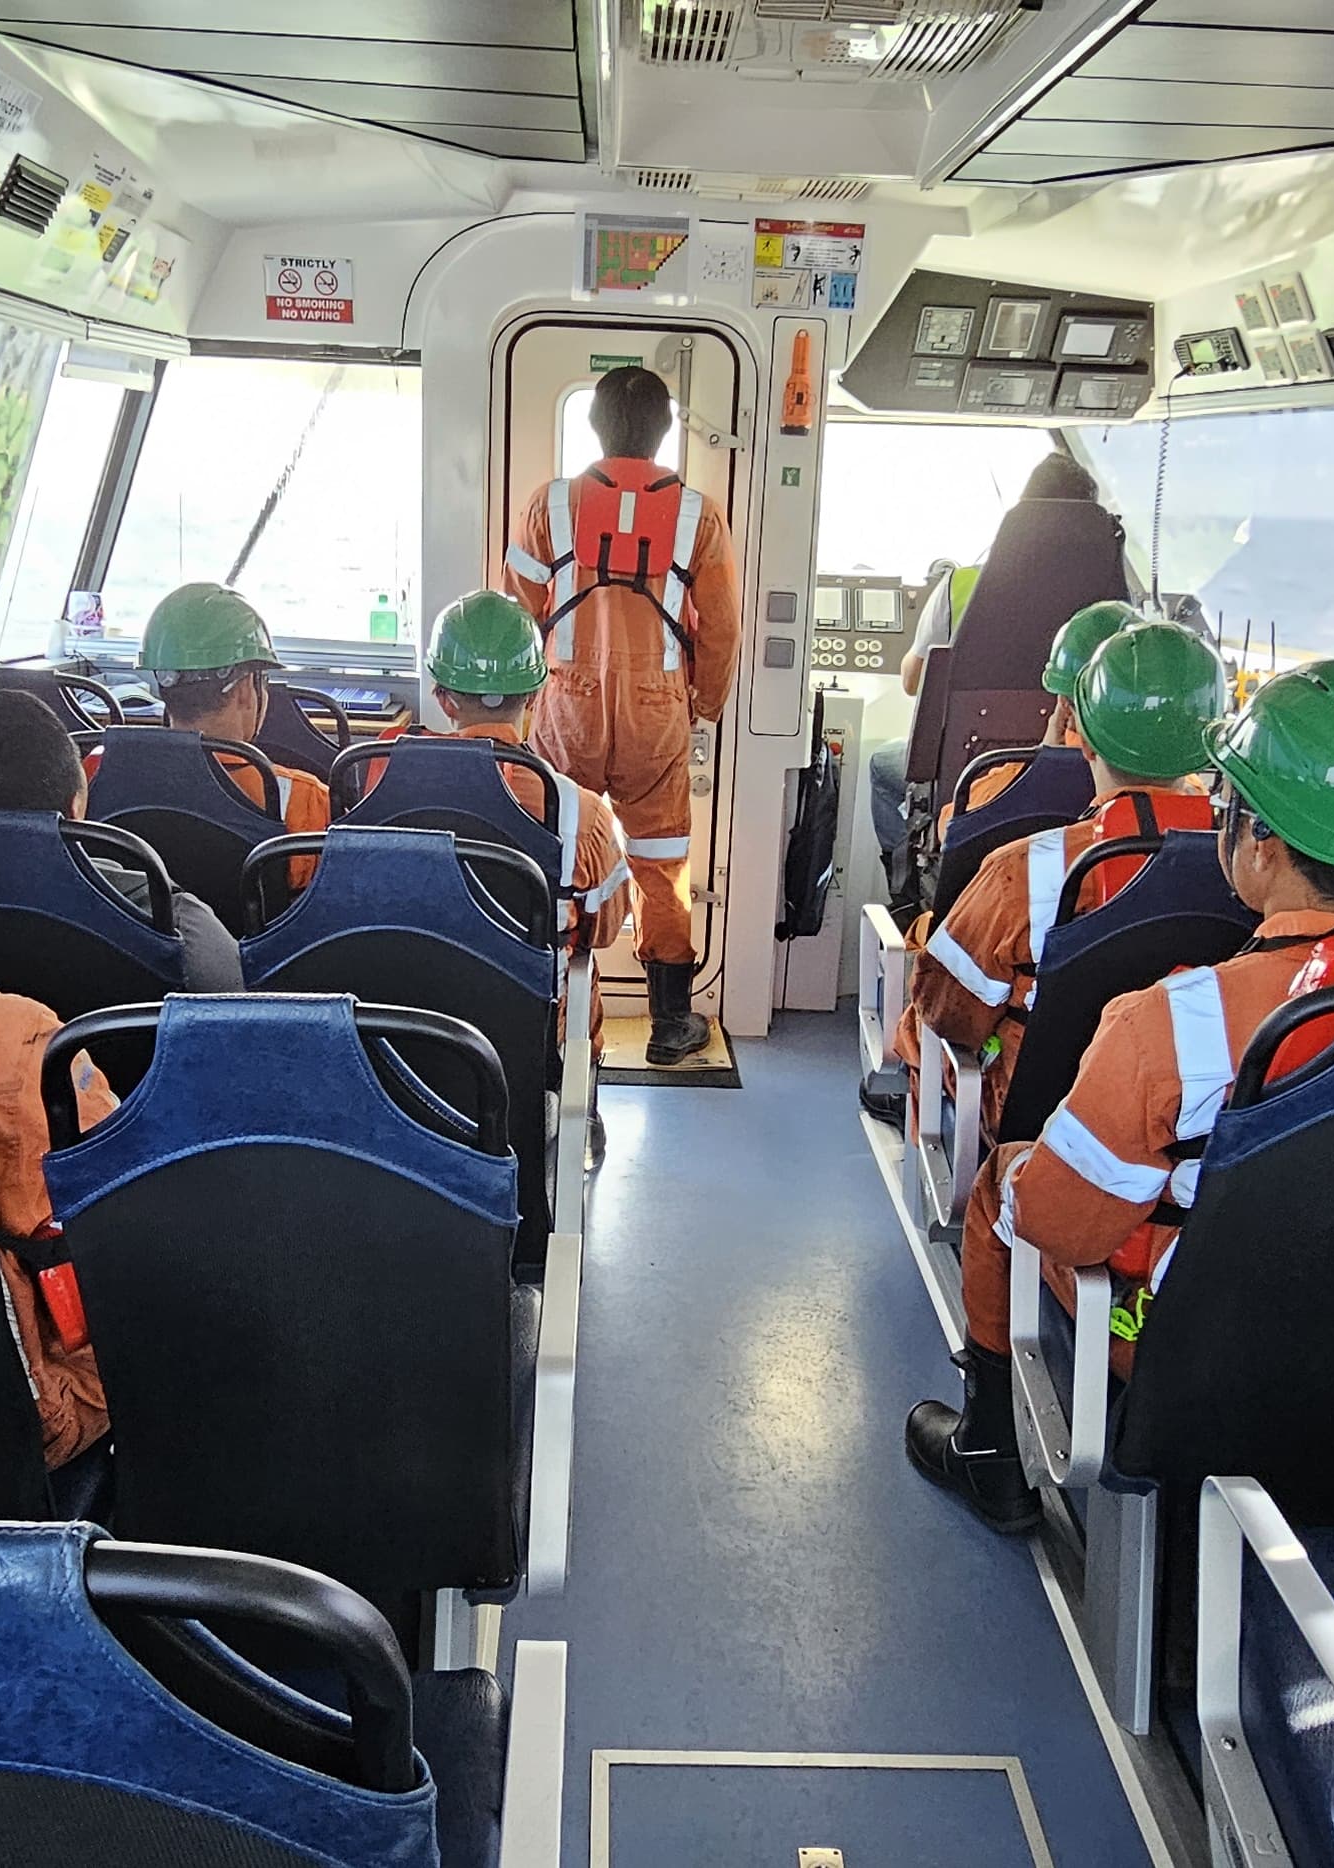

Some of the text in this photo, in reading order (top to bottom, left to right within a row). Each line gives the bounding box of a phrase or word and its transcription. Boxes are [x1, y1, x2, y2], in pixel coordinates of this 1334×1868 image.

[281, 257, 336, 269] STRICTLY
[276, 297, 345, 310] NO SMOKING
[282, 309, 341, 321] NO VAPING
